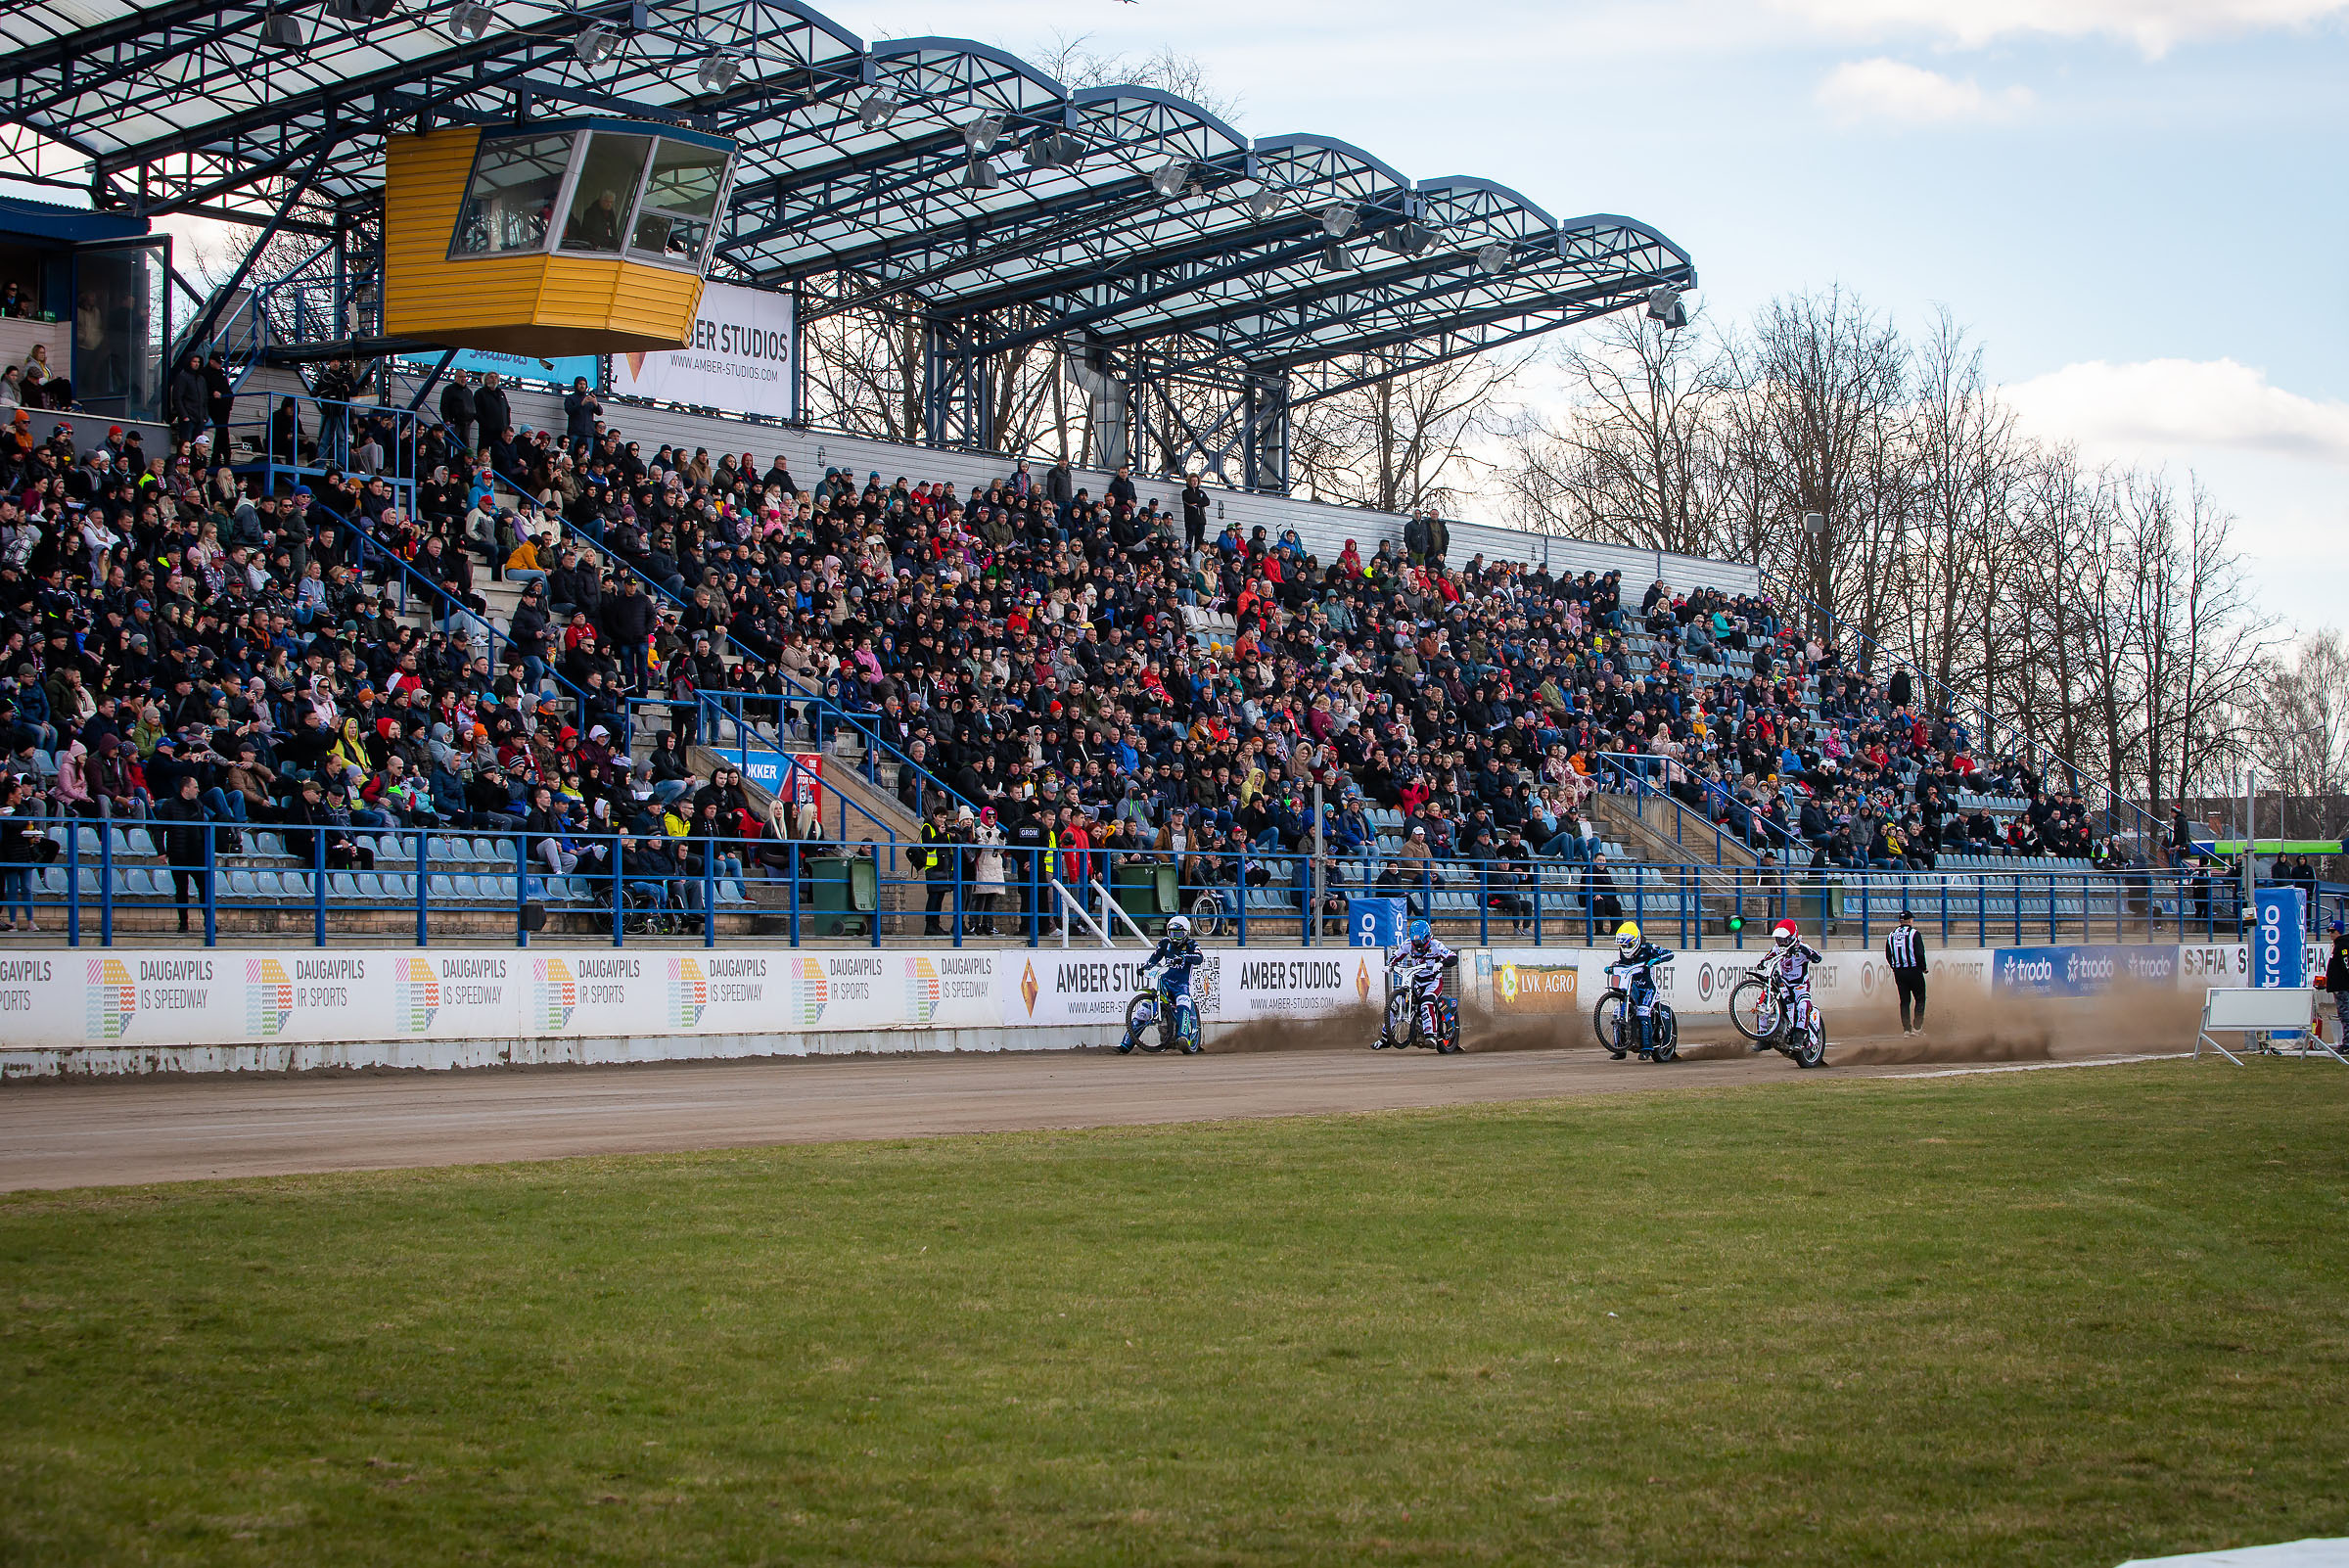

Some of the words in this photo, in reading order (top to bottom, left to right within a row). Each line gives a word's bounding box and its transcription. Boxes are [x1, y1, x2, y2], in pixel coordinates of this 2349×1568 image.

[689, 319, 716, 351] BER
[720, 323, 788, 363] STUDIOS
[670, 353, 778, 383] WWW.AMBER-STUDIOS.COM
[2261, 904, 2280, 988] trodo
[140, 960, 213, 981] DAUGAVPILS
[297, 959, 365, 980] DAUGAVPILS
[442, 958, 507, 979] DAUGAVPILS
[578, 959, 640, 978] DAUGAVPILS
[710, 958, 766, 977] DAUGAVPILS
[830, 958, 883, 976] DAUGAVPILS
[942, 958, 991, 975] DAUGAVPILS
[2017, 956, 2052, 982] trodo
[2080, 954, 2114, 979] trodo
[2139, 954, 2171, 978] trodo
[2306, 947, 2326, 973] FIA
[0, 960, 52, 982] GAVPILS
[1057, 963, 1109, 992] AMBER
[1113, 963, 1150, 992] STUD
[1240, 961, 1286, 990] AMBER
[1289, 961, 1342, 989] STUDIOS
[1809, 965, 1838, 989] PTIBET
[711, 985, 718, 1002] IS
[720, 984, 762, 1002] SPEEDWAY
[831, 983, 839, 1000] IR
[841, 983, 869, 1000] SPORTS
[942, 982, 949, 998] IS
[951, 982, 989, 998] SPEEDWAY
[1521, 975, 1542, 992] LVK
[1545, 974, 1575, 992] AGRO
[0, 990, 31, 1011] ORTS
[141, 990, 151, 1010] IS
[154, 990, 208, 1009] SPEEDWAY
[297, 989, 307, 1007] IR
[310, 988, 347, 1007] SPORTS
[443, 987, 452, 1005] IS
[455, 986, 502, 1004] SPEEDWAY
[579, 986, 588, 1003] IR
[590, 985, 624, 1003] SPORTS
[1250, 997, 1334, 1010] WWW.AMBER-STUDIOS.COM
